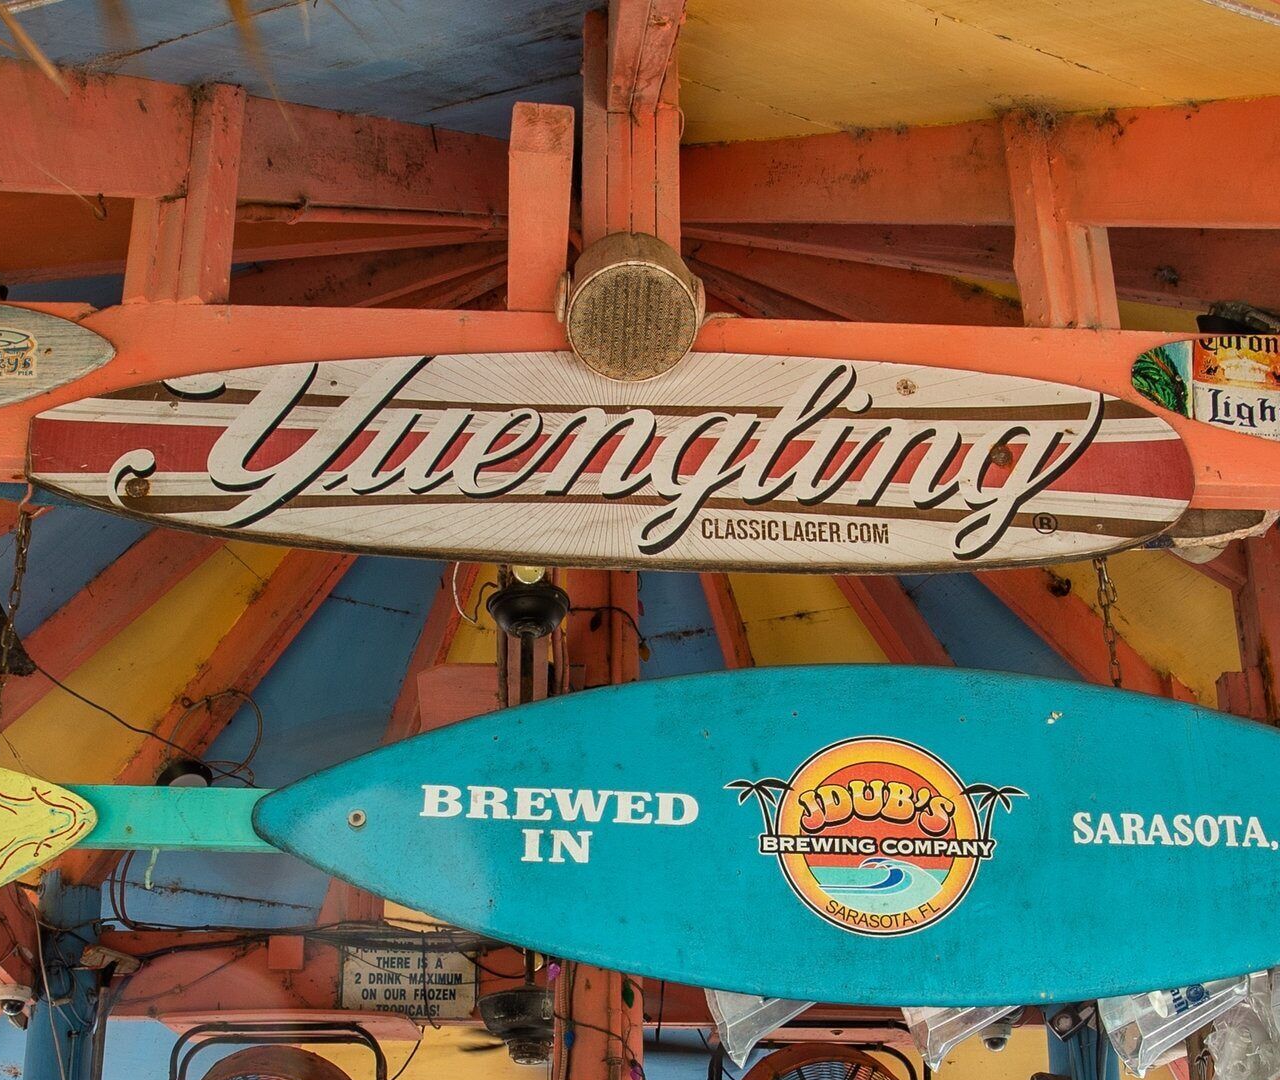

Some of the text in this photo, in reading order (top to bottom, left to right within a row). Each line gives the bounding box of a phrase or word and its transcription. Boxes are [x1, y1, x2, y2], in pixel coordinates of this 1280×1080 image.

[109, 355, 1105, 560] Yuengling
[419, 784, 699, 825] BREWED
[798, 779, 956, 837] JDUB'S
[521, 828, 593, 864] IN
[762, 836, 995, 857] BREWING COMPANY
[1073, 811, 1279, 850] SARASOTA,
[825, 899, 942, 929] SARASOTA, FL
[354, 972, 463, 985] 2 DRINK MAXIMUM
[376, 956, 444, 970] THERE IS A
[361, 988, 456, 1001] ON OUR FROZEN
